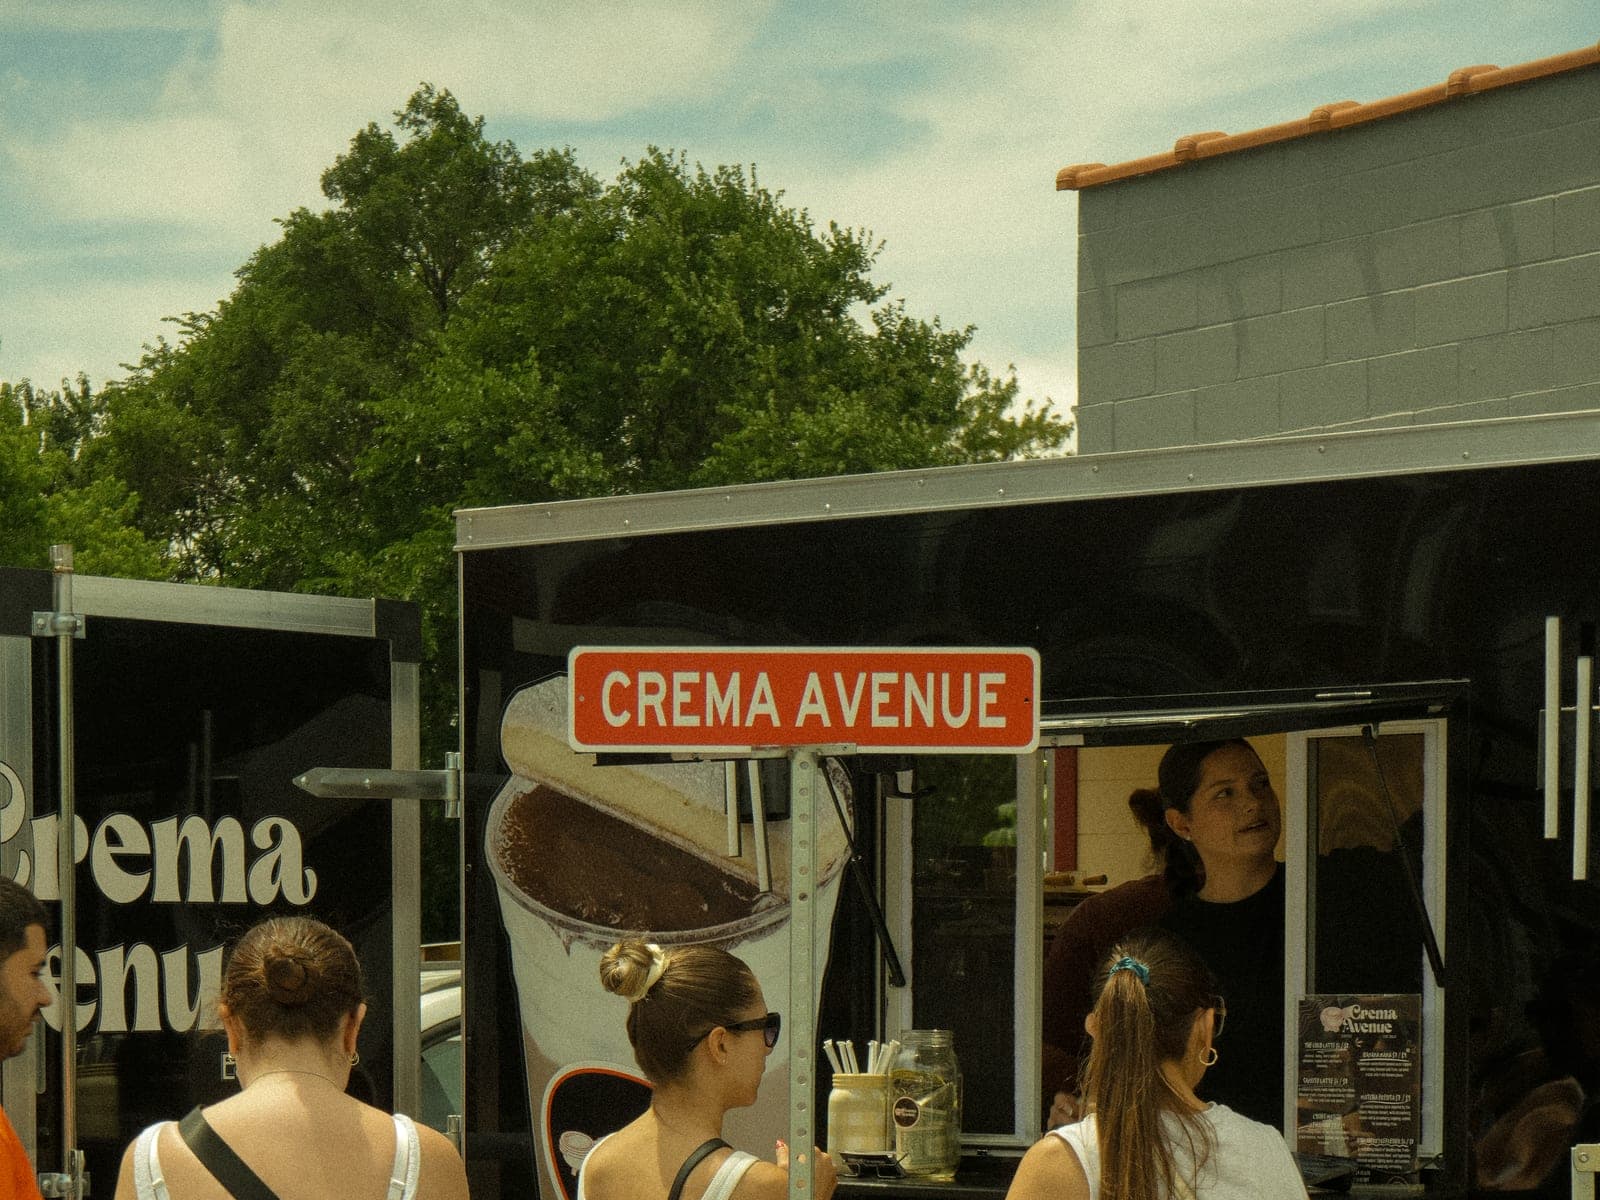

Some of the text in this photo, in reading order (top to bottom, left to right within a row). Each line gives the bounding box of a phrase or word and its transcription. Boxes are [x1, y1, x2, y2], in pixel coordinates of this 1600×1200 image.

[602, 671, 1006, 729] CREMA AVENUE
[1350, 1004, 1398, 1019] Crema
[1343, 1017, 1392, 1033] Avenue
